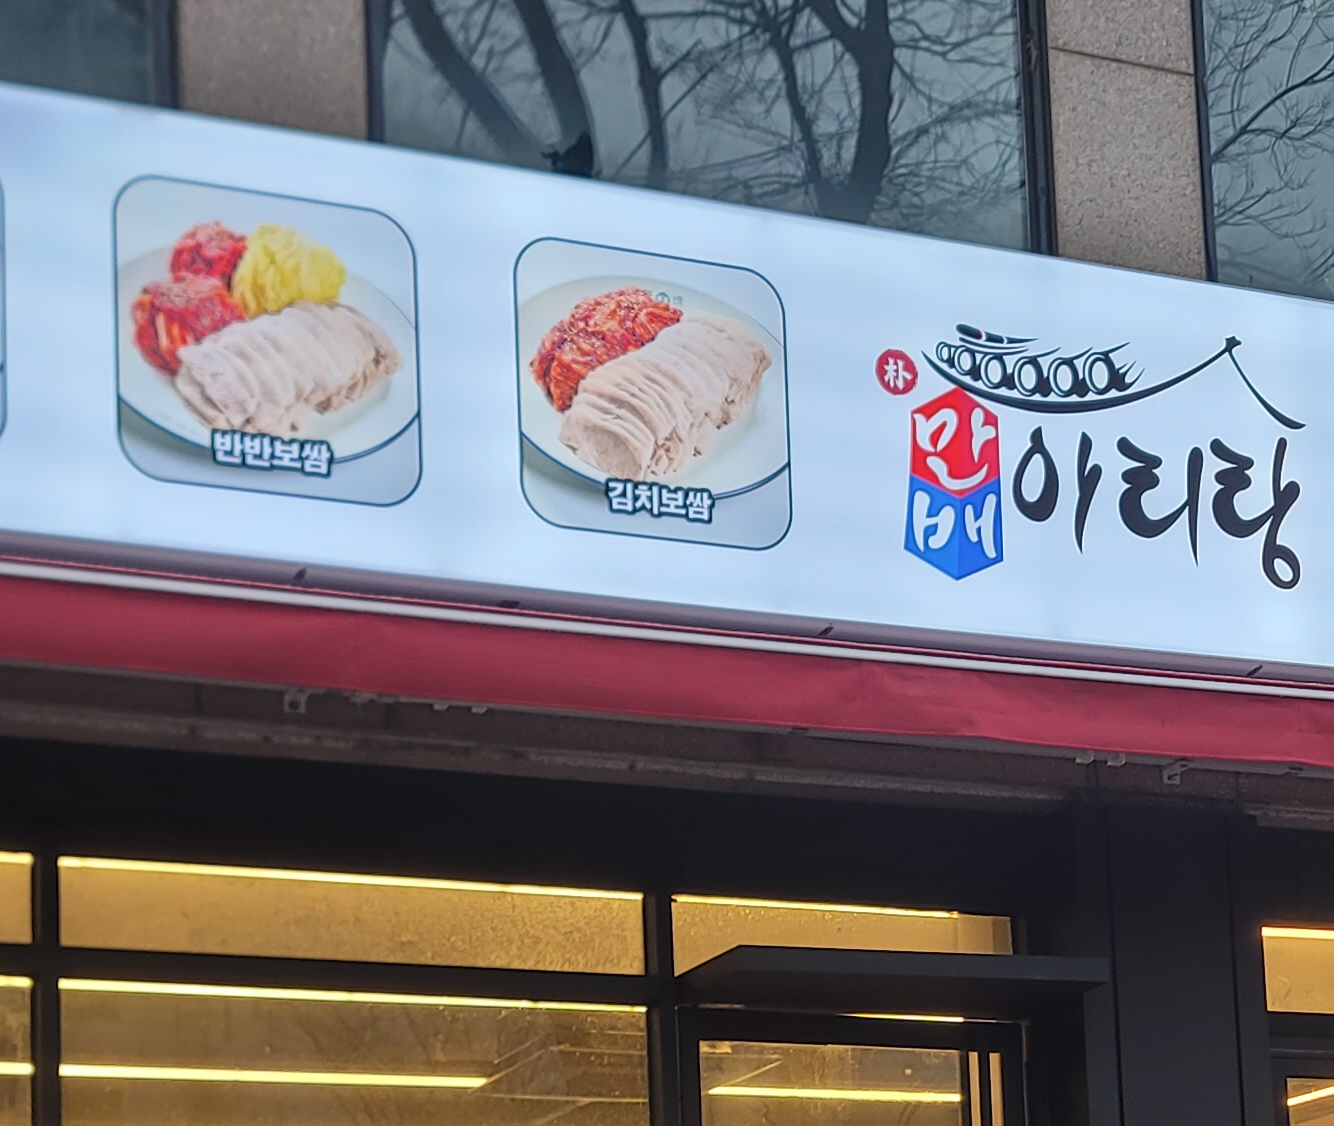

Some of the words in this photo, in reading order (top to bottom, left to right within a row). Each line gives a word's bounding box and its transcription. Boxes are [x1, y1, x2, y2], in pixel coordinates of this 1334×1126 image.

[882, 357, 914, 391] 朴
[212, 429, 332, 478] 반반보쌈
[606, 480, 713, 522] 김치보쌈
[912, 406, 997, 560] 만배
[1013, 426, 1303, 590] 아리랑
